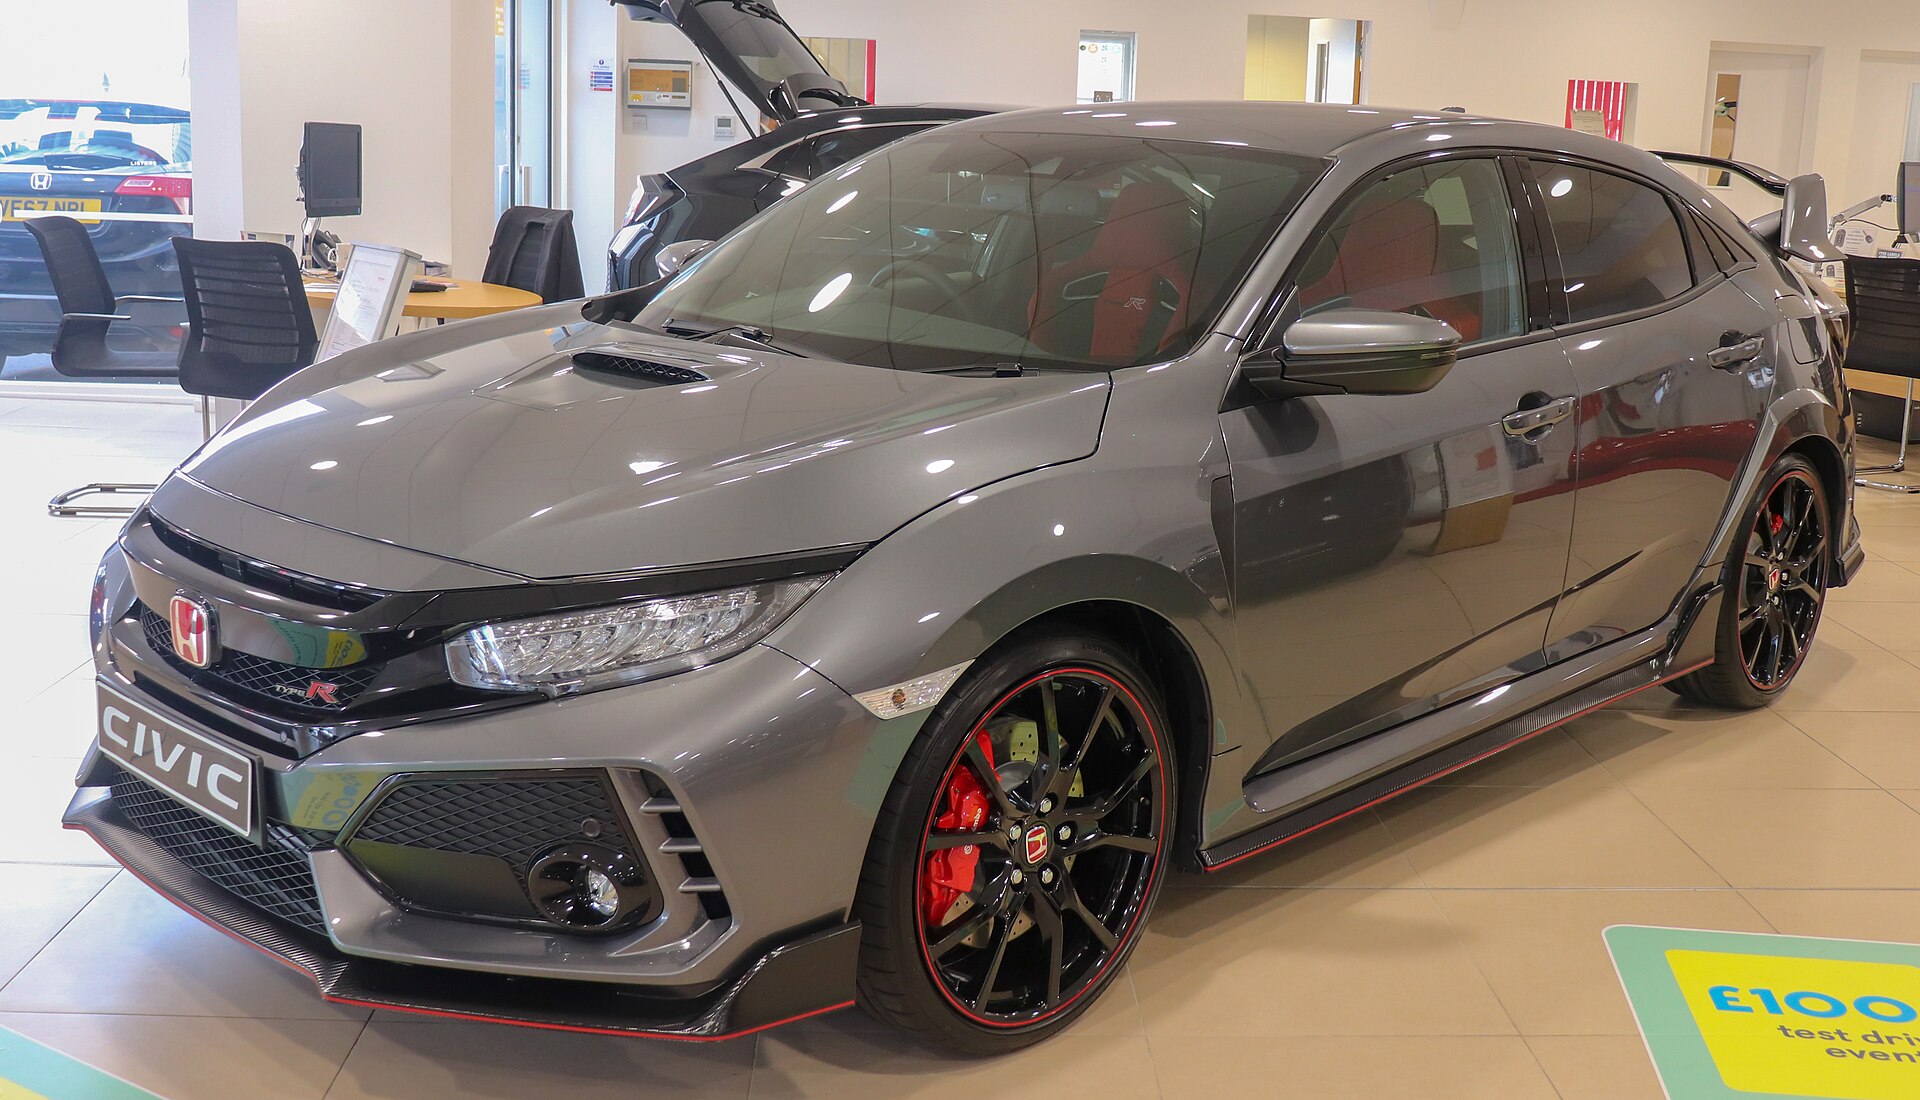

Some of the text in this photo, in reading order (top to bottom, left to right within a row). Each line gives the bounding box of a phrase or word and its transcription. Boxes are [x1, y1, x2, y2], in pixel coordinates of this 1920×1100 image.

[275, 681, 339, 704] TYPE R
[103, 705, 243, 810] CIVIC
[1777, 1025, 1852, 1042] test
